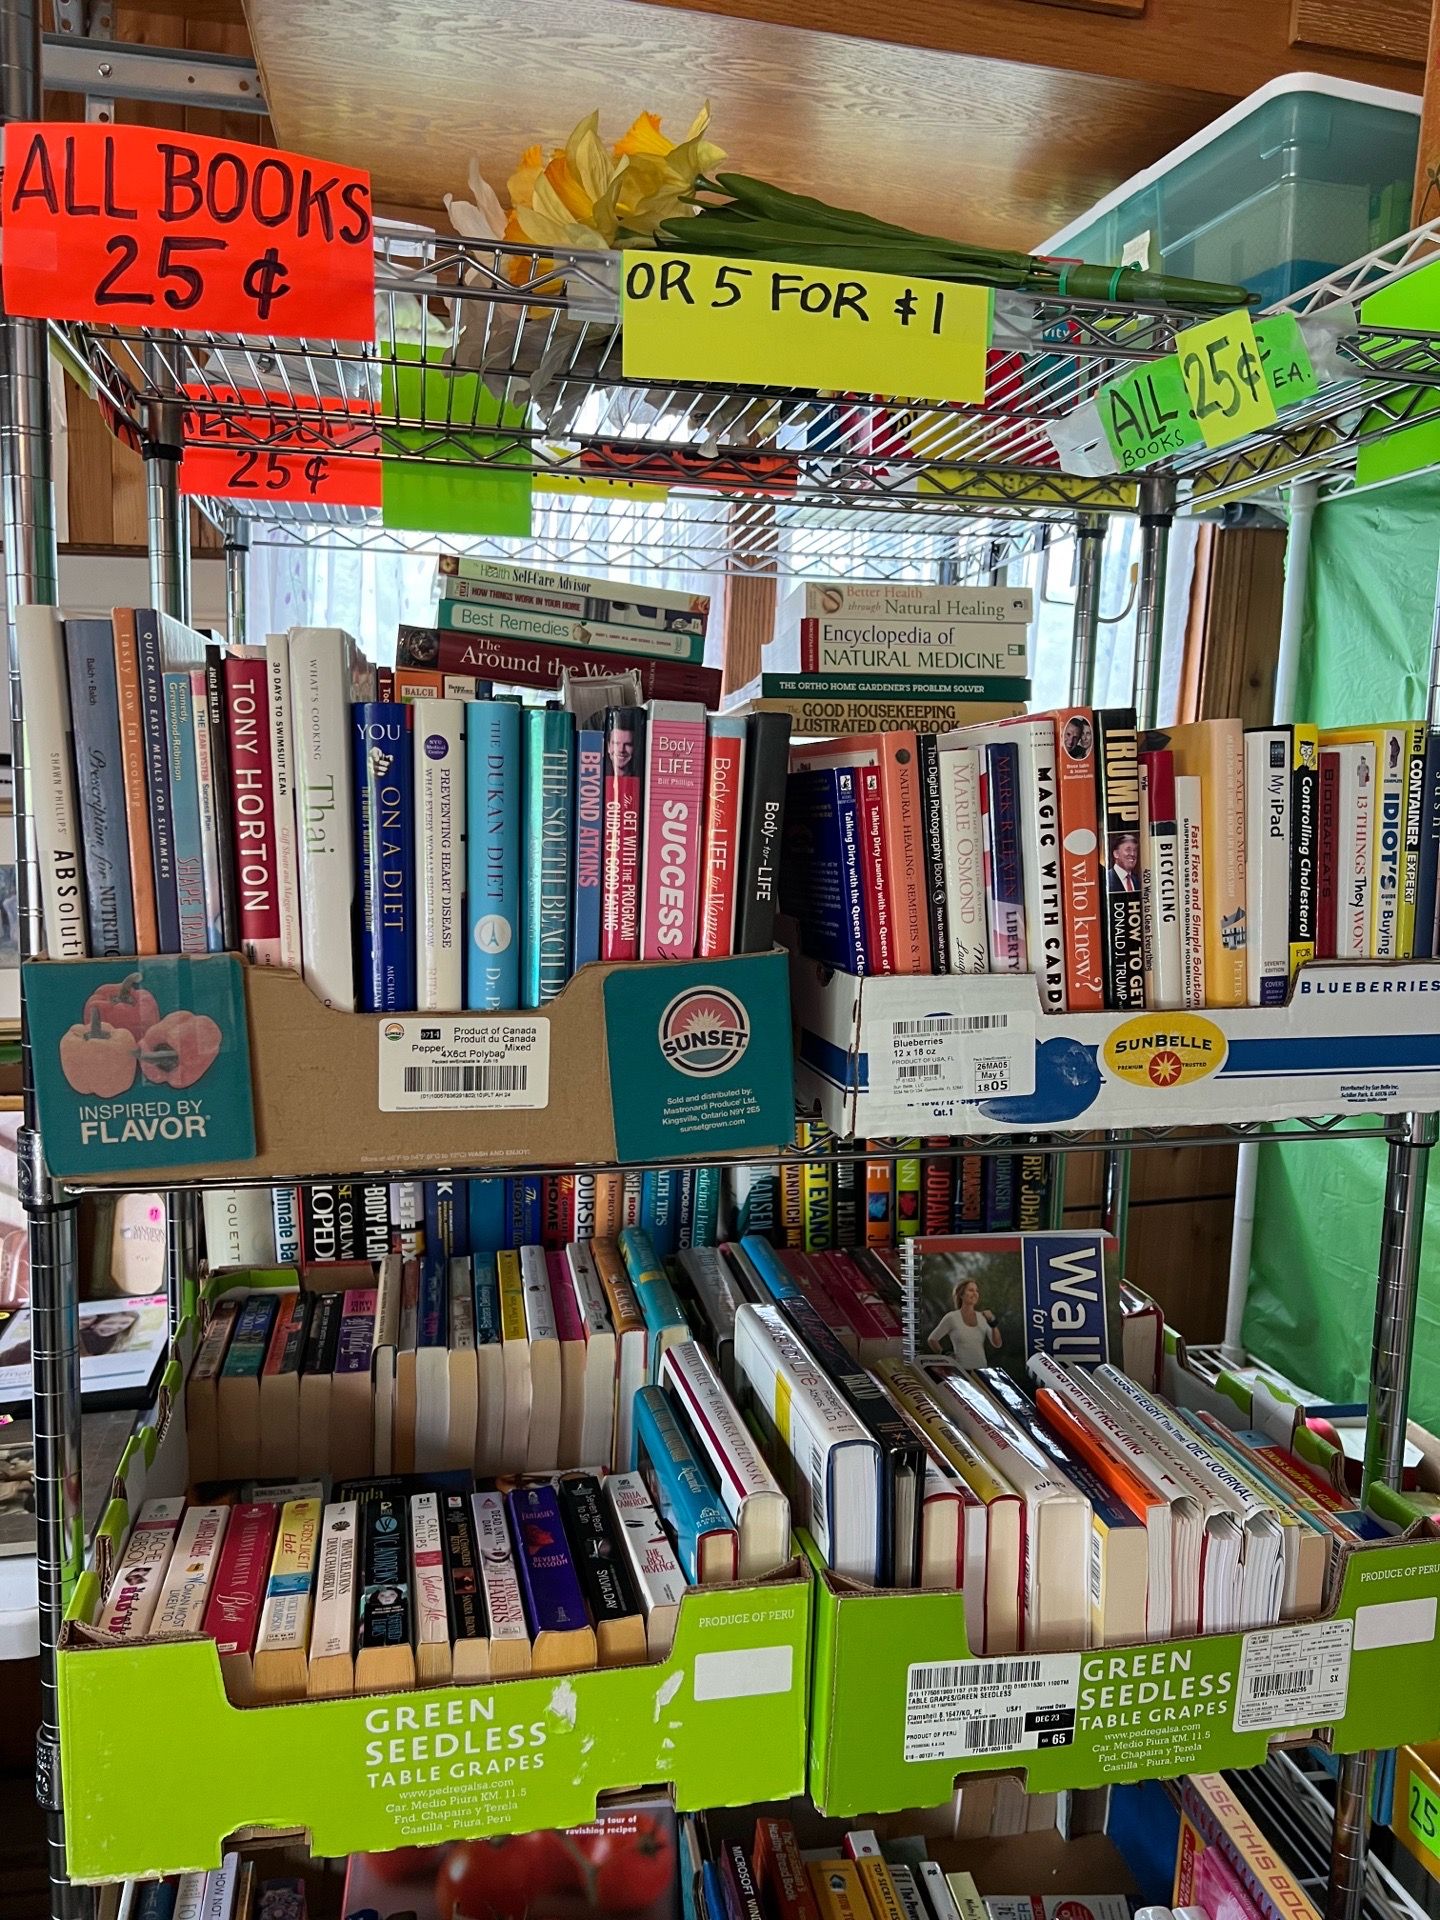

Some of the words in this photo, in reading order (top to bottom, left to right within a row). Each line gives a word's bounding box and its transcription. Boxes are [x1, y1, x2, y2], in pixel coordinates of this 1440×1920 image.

[11, 133, 138, 219] ALL
[157, 144, 370, 244] BOOKS
[625, 260, 694, 307] OR
[711, 268, 752, 308] 5
[771, 273, 870, 322] FOR
[894, 290, 945, 335] $1
[1109, 375, 1178, 446] ALL
[1184, 336, 1260, 419] 25¢
[1273, 362, 1311, 388] EA.
[1122, 428, 1185, 469] BOOKS
[481, 566, 510, 580] Health
[513, 570, 555, 588] Self-Care
[557, 576, 591, 593] Advisor
[847, 586, 880, 598] Better
[885, 587, 922, 599] Health
[462, 609, 493, 627] Best
[500, 614, 569, 635] Remedies
[848, 602, 882, 612] through
[885, 600, 941, 615] Natural
[947, 601, 1005, 620] Healing
[144, 632, 154, 670] QUICK
[823, 624, 932, 648] Encyclopedia
[938, 627, 955, 644] of
[273, 662, 280, 673] 30
[460, 645, 540, 673] Around
[548, 658, 579, 678] the
[823, 650, 911, 668] NATURAL
[918, 652, 1006, 669] MEDICINE
[148, 679, 156, 702] AND
[274, 678, 282, 701] DAYS
[310, 659, 319, 702] WHAT'S
[780, 682, 796, 690] THE
[798, 682, 829, 690] ORTHO
[830, 682, 856, 691] HOME
[858, 683, 911, 692] GARDENER'S
[912, 684, 951, 692] PROBLEM
[953, 684, 984, 693] SOLVER
[150, 710, 160, 737] EASY
[232, 679, 258, 754] TONY
[275, 706, 282, 716] TO
[791, 719, 876, 732] LLUSTRATED
[882, 720, 959, 733] COOKBOOK
[802, 703, 844, 718] GOOD
[850, 703, 956, 719] HOUSEKEEPING
[276, 722, 286, 769] SWIMSUIT
[312, 708, 321, 760] COOKING
[357, 724, 400, 740] YOU
[659, 736, 695, 754] Body
[1412, 728, 1423, 752] The
[153, 745, 162, 782] MEALS
[658, 759, 693, 774] LIFE
[927, 744, 937, 766] The
[278, 773, 286, 795] LEAN
[580, 751, 600, 822] BEYOND
[928, 767, 939, 799] Digital
[1106, 729, 1140, 822] TRUMP
[1269, 774, 1284, 794] My
[156, 790, 164, 810] FOR
[381, 786, 400, 828] ON
[441, 768, 450, 849] PREVENTING
[486, 754, 505, 834] DUKAN
[953, 762, 969, 831] MARIE
[1037, 767, 1055, 847] MAGIC
[1406, 760, 1422, 846] CONTAINER
[304, 774, 335, 853] Thai
[623, 811, 637, 831] GET
[930, 800, 943, 861] Photography
[1270, 800, 1284, 840] iPad
[1298, 776, 1312, 855] Controlling
[158, 818, 169, 878] SLIMMERS
[235, 769, 270, 911] HORTON
[383, 842, 401, 856] A
[623, 838, 636, 866] WITH
[1191, 825, 1200, 849] Fast
[1380, 793, 1400, 890] IDIOT'S
[441, 852, 450, 893] HEART
[486, 847, 505, 902] DIET
[578, 828, 599, 887] ATKINS
[657, 800, 688, 946] SUCCESS
[1192, 855, 1200, 880] Fixes
[622, 869, 632, 882] THE
[934, 864, 943, 888] Book
[956, 839, 974, 924] OSMOND
[1071, 860, 1096, 910] who
[1160, 843, 1175, 923] BICYCLING
[1404, 853, 1418, 904] EXPERT
[383, 871, 403, 932] DIET
[1042, 861, 1058, 926] WITH
[1192, 889, 1201, 910] and
[1300, 858, 1312, 938] Cholesterol
[442, 897, 451, 948] DISEASE
[621, 885, 635, 940] PROGRAM!
[1112, 901, 1124, 949] DONALD
[1128, 901, 1141, 941] HOW
[1006, 911, 1020, 970] LIBERTY
[1071, 915, 1103, 990] knew?
[1129, 948, 1142, 971] TO
[1115, 961, 1127, 1001] TRUMP
[1130, 980, 1143, 1008] GET
[1301, 980, 1440, 994] BLUEBERRIES
[454, 1027, 488, 1035] Product
[491, 1027, 500, 1035] of
[503, 1027, 536, 1035] Canada
[663, 1030, 748, 1057] SUNSET
[894, 1039, 943, 1047] Blueberries
[412, 1045, 444, 1053] Pepper
[470, 1050, 505, 1059] Polybag
[79, 1102, 172, 1121] INSPIRED
[178, 1100, 203, 1115] BY
[680, 1118, 746, 1133] sunsetgrown.com
[81, 1116, 210, 1145] FLAVOR
[1186, 1443, 1213, 1462] DIET
[1206, 1462, 1253, 1502] JOURNAL
[416, 1515, 427, 1550] PHILLIPS
[426, 1518, 439, 1550] CARLY
[488, 1579, 508, 1623] HARRIS
[699, 1616, 749, 1628] PRODUCE
[752, 1613, 766, 1623] OF
[769, 1609, 794, 1621] PERU
[1083, 1650, 1191, 1681] GREEN
[1080, 1672, 1231, 1710] SEEDLESS
[365, 1696, 494, 1733] GREEN
[1051, 1714, 1060, 1722] 23
[1080, 1711, 1141, 1730] TABLE
[1149, 1701, 1227, 1723] GRAPES
[366, 1722, 546, 1766] SEEDLESS
[367, 1766, 440, 1788] TABLE
[450, 1753, 544, 1778] GRAPES
[399, 1778, 514, 1799] www.pedregalsa.com
[1204, 1784, 1239, 1827] USE
[1231, 1819, 1276, 1870] THIS
[732, 1846, 754, 1896] MICROSOFT
